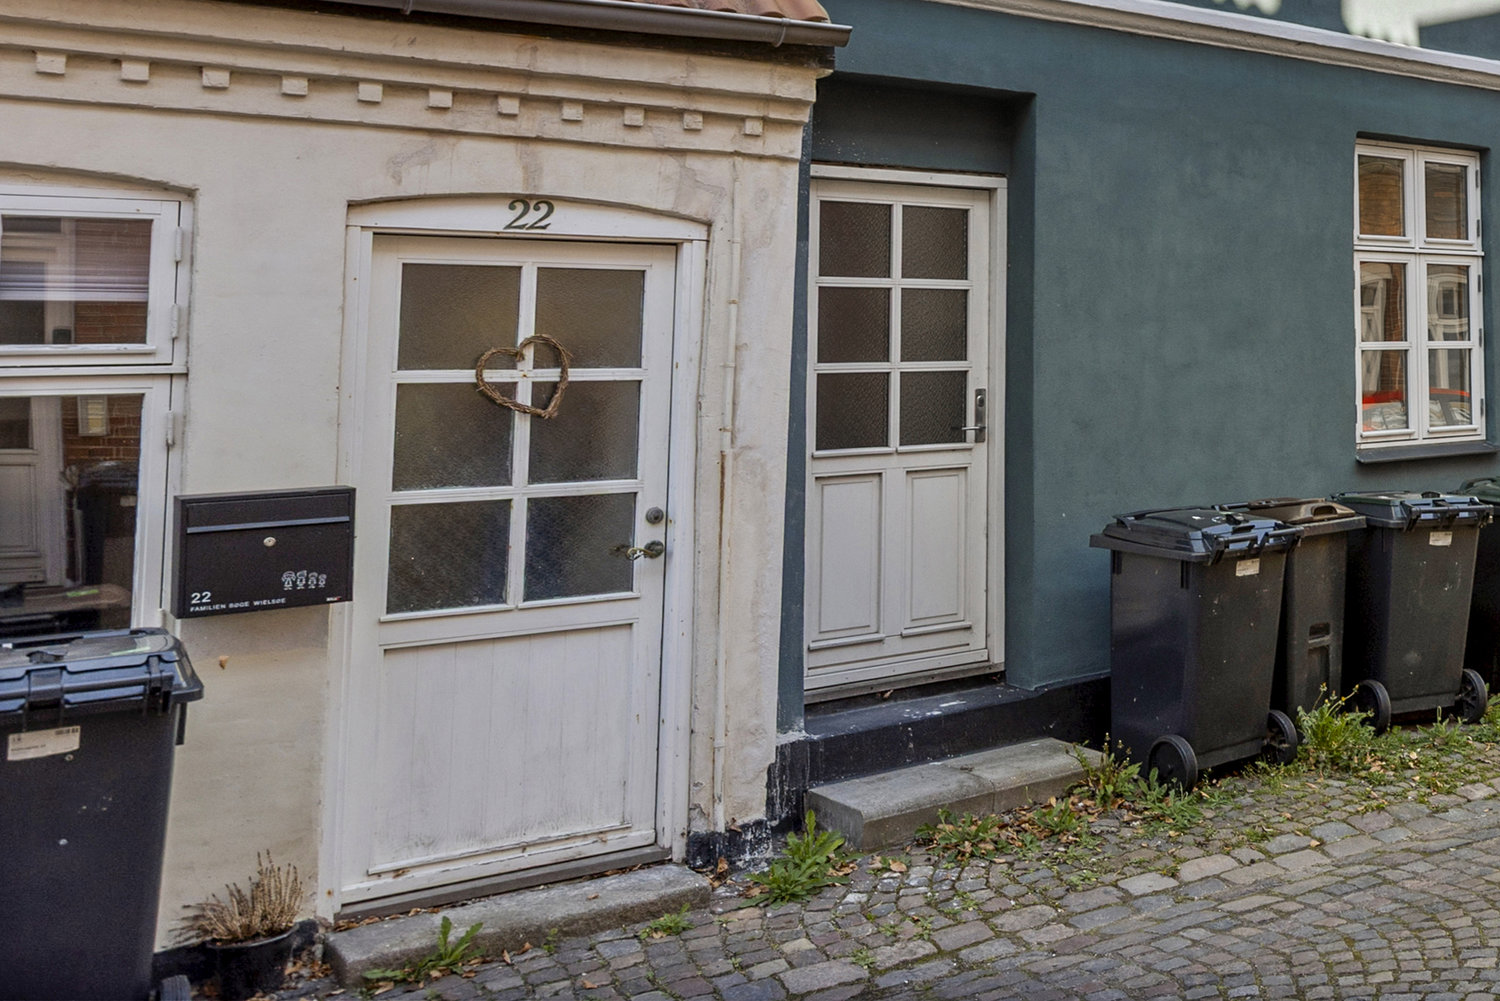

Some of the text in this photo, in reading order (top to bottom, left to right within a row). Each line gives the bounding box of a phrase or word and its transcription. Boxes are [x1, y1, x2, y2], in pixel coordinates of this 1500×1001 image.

[503, 199, 555, 230] 22
[191, 591, 211, 604] 22
[190, 603, 226, 612] FAMILIEN
